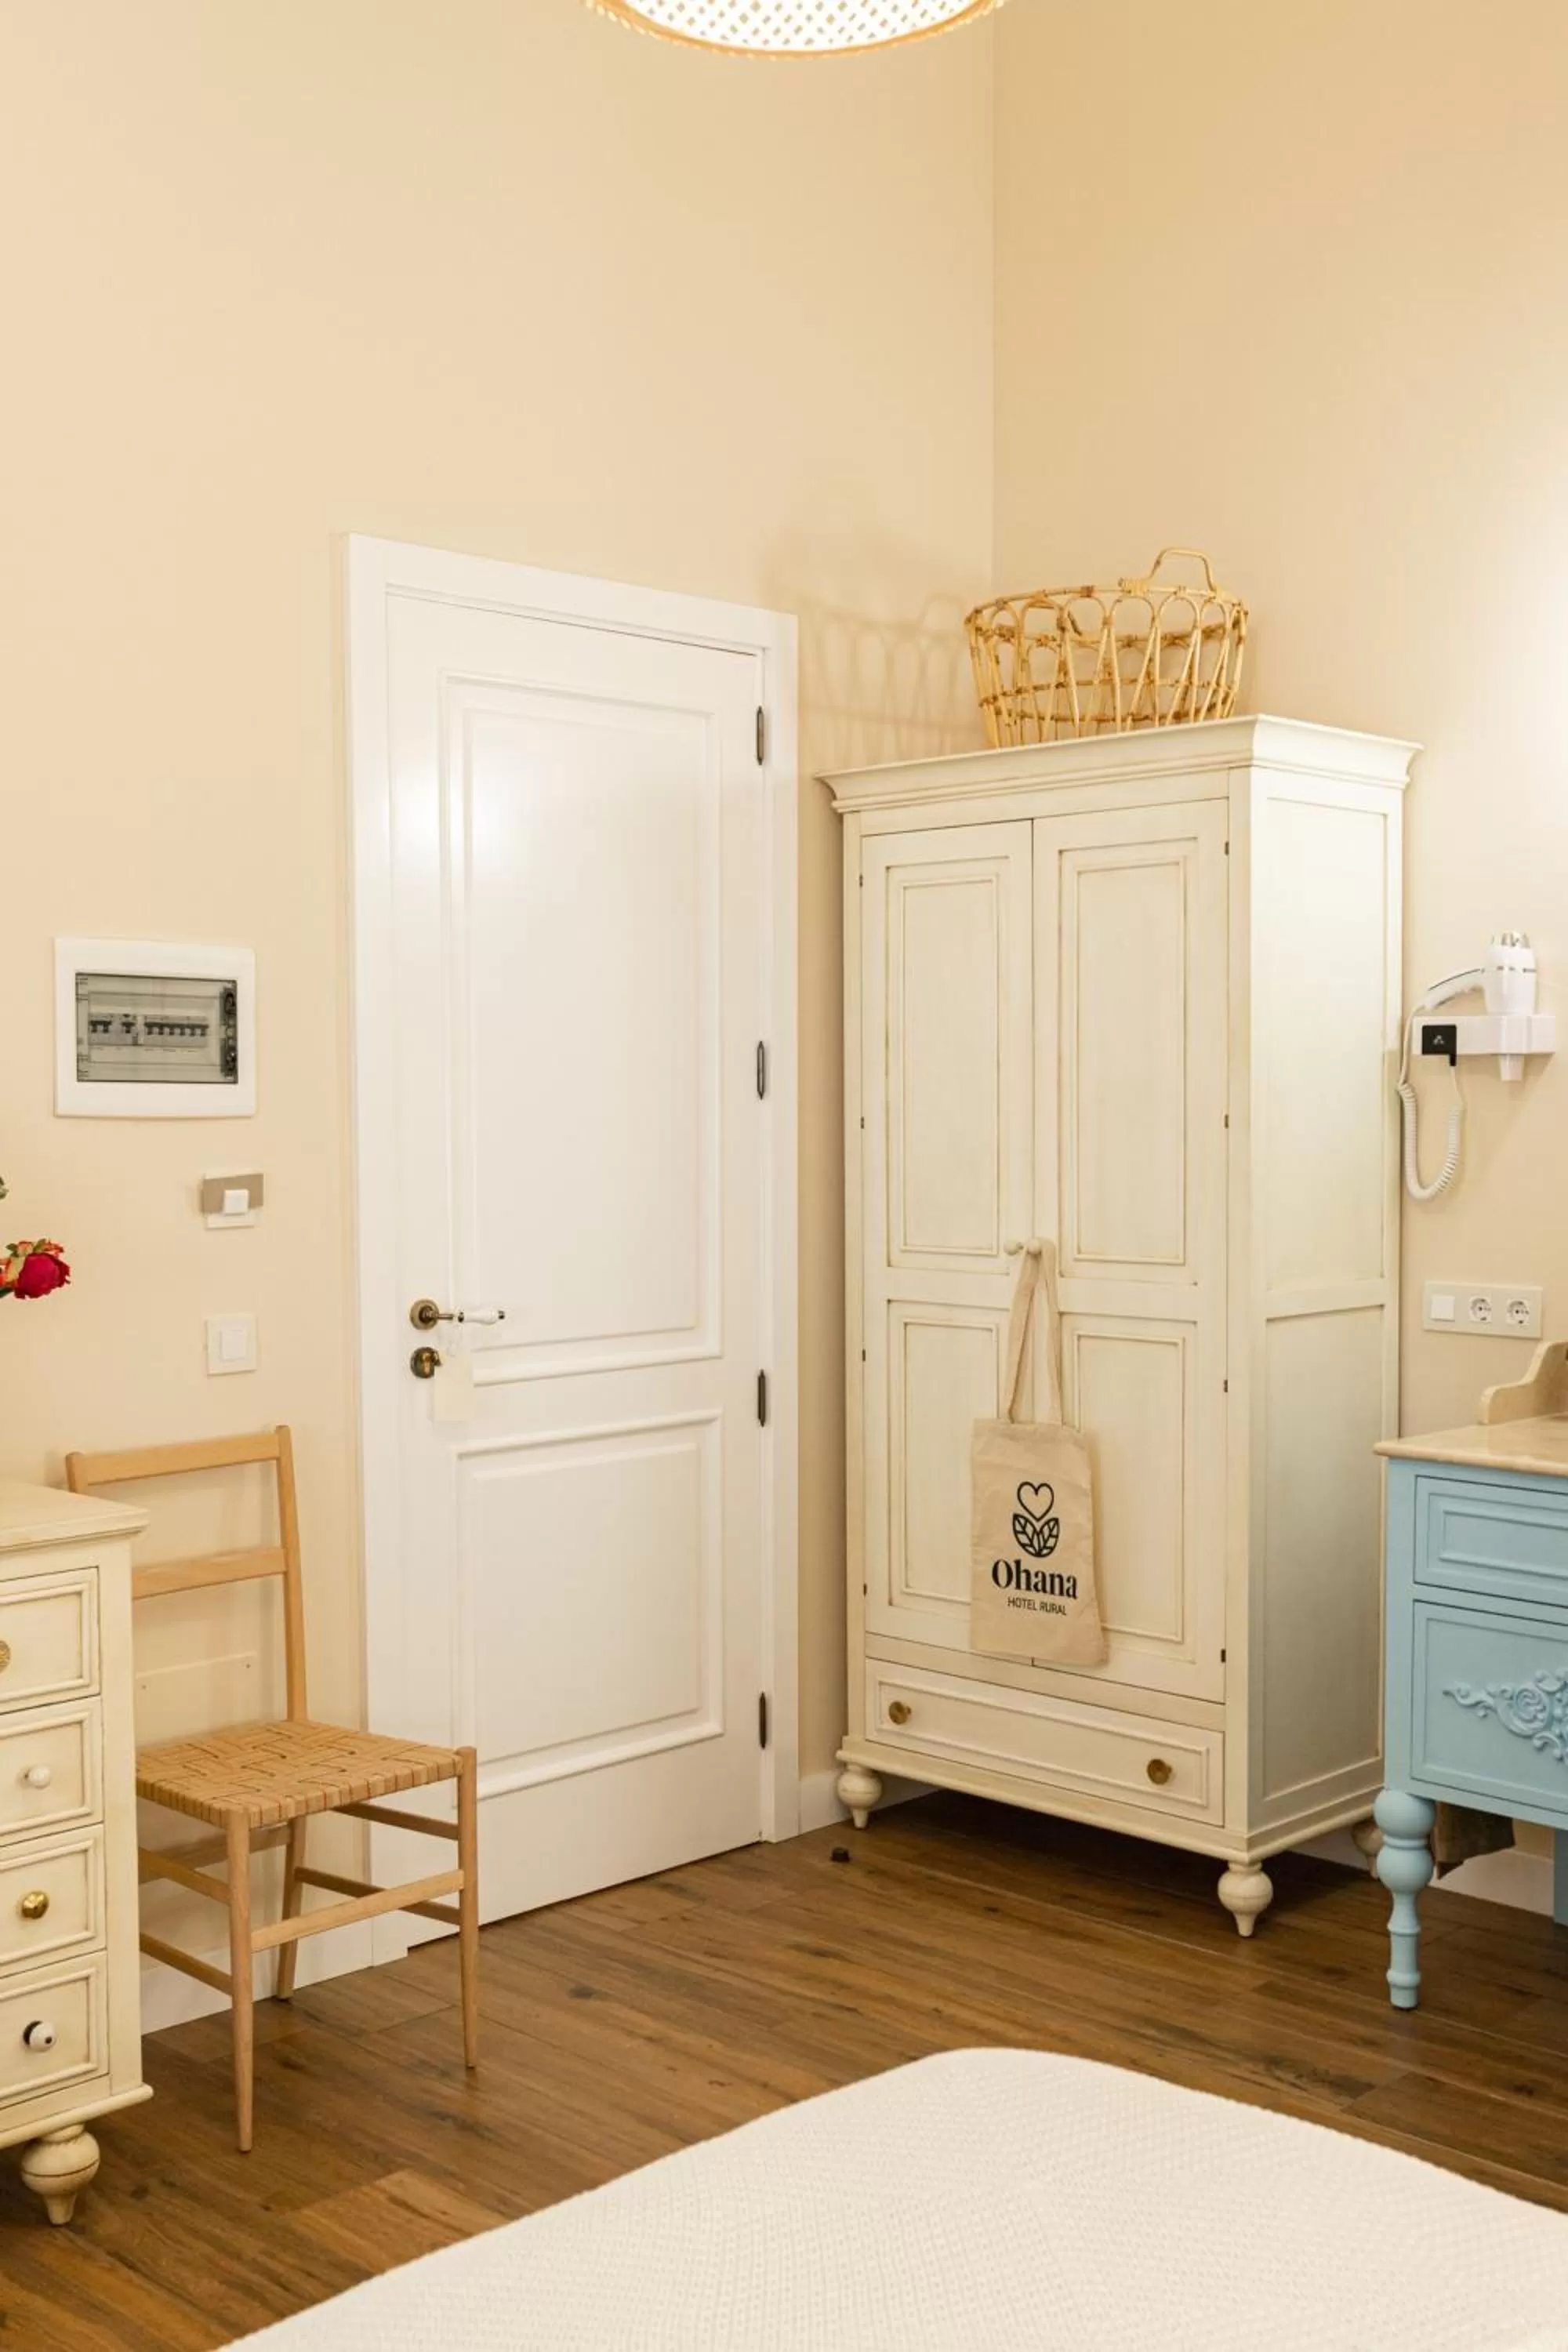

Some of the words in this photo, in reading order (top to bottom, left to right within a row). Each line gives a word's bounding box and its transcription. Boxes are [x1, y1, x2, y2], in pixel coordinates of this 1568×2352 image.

[992, 1559, 1078, 1599] Ohana
[1007, 1597, 1037, 1611] HOTEL
[1040, 1602, 1067, 1616] RURAL
